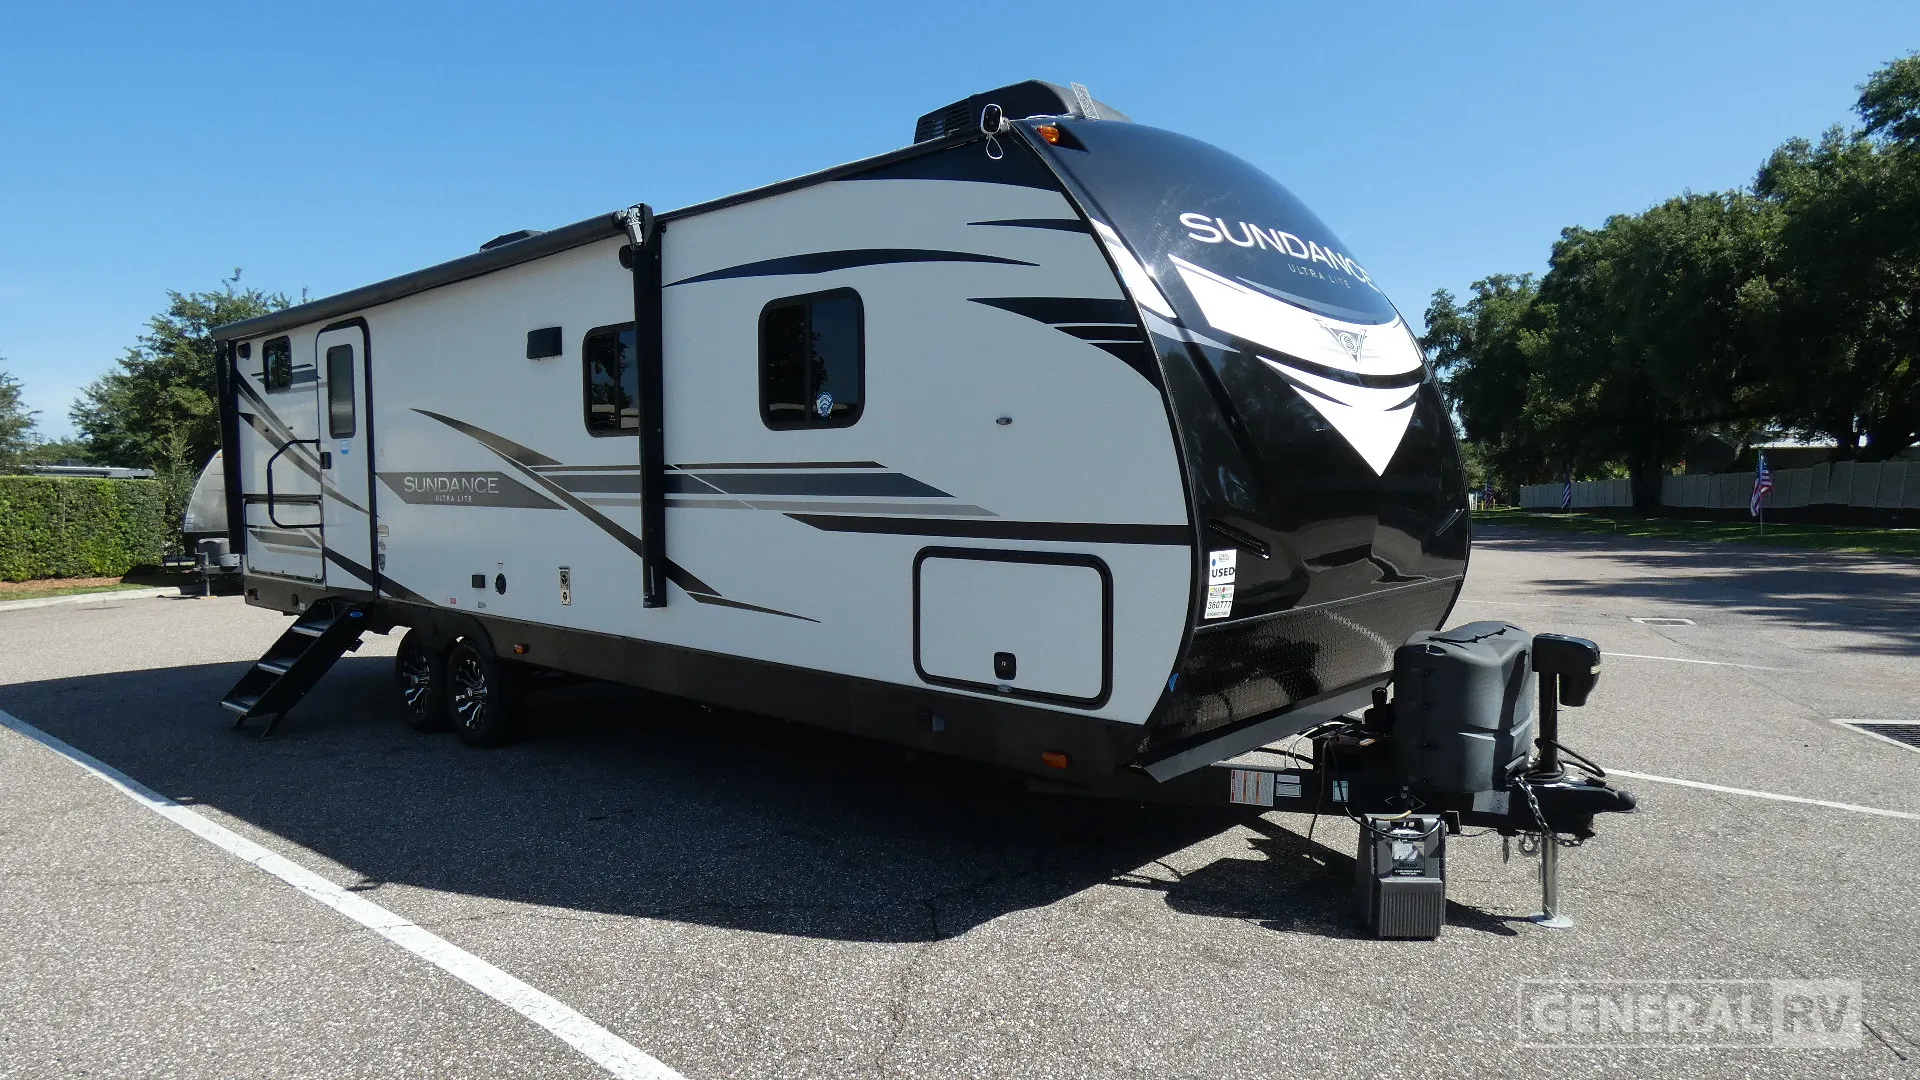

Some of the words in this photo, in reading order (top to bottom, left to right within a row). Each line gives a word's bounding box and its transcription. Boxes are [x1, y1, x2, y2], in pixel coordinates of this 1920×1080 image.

[1179, 212, 1380, 292] SUNDANCE
[1287, 263, 1326, 281] ULTRA
[1328, 275, 1351, 289] LITE
[404, 476, 500, 494] SUNDANCE
[435, 494, 455, 502] ULTRA
[457, 495, 472, 503] LITE
[1211, 566, 1235, 578] USED
[1207, 600, 1232, 610] 360777
